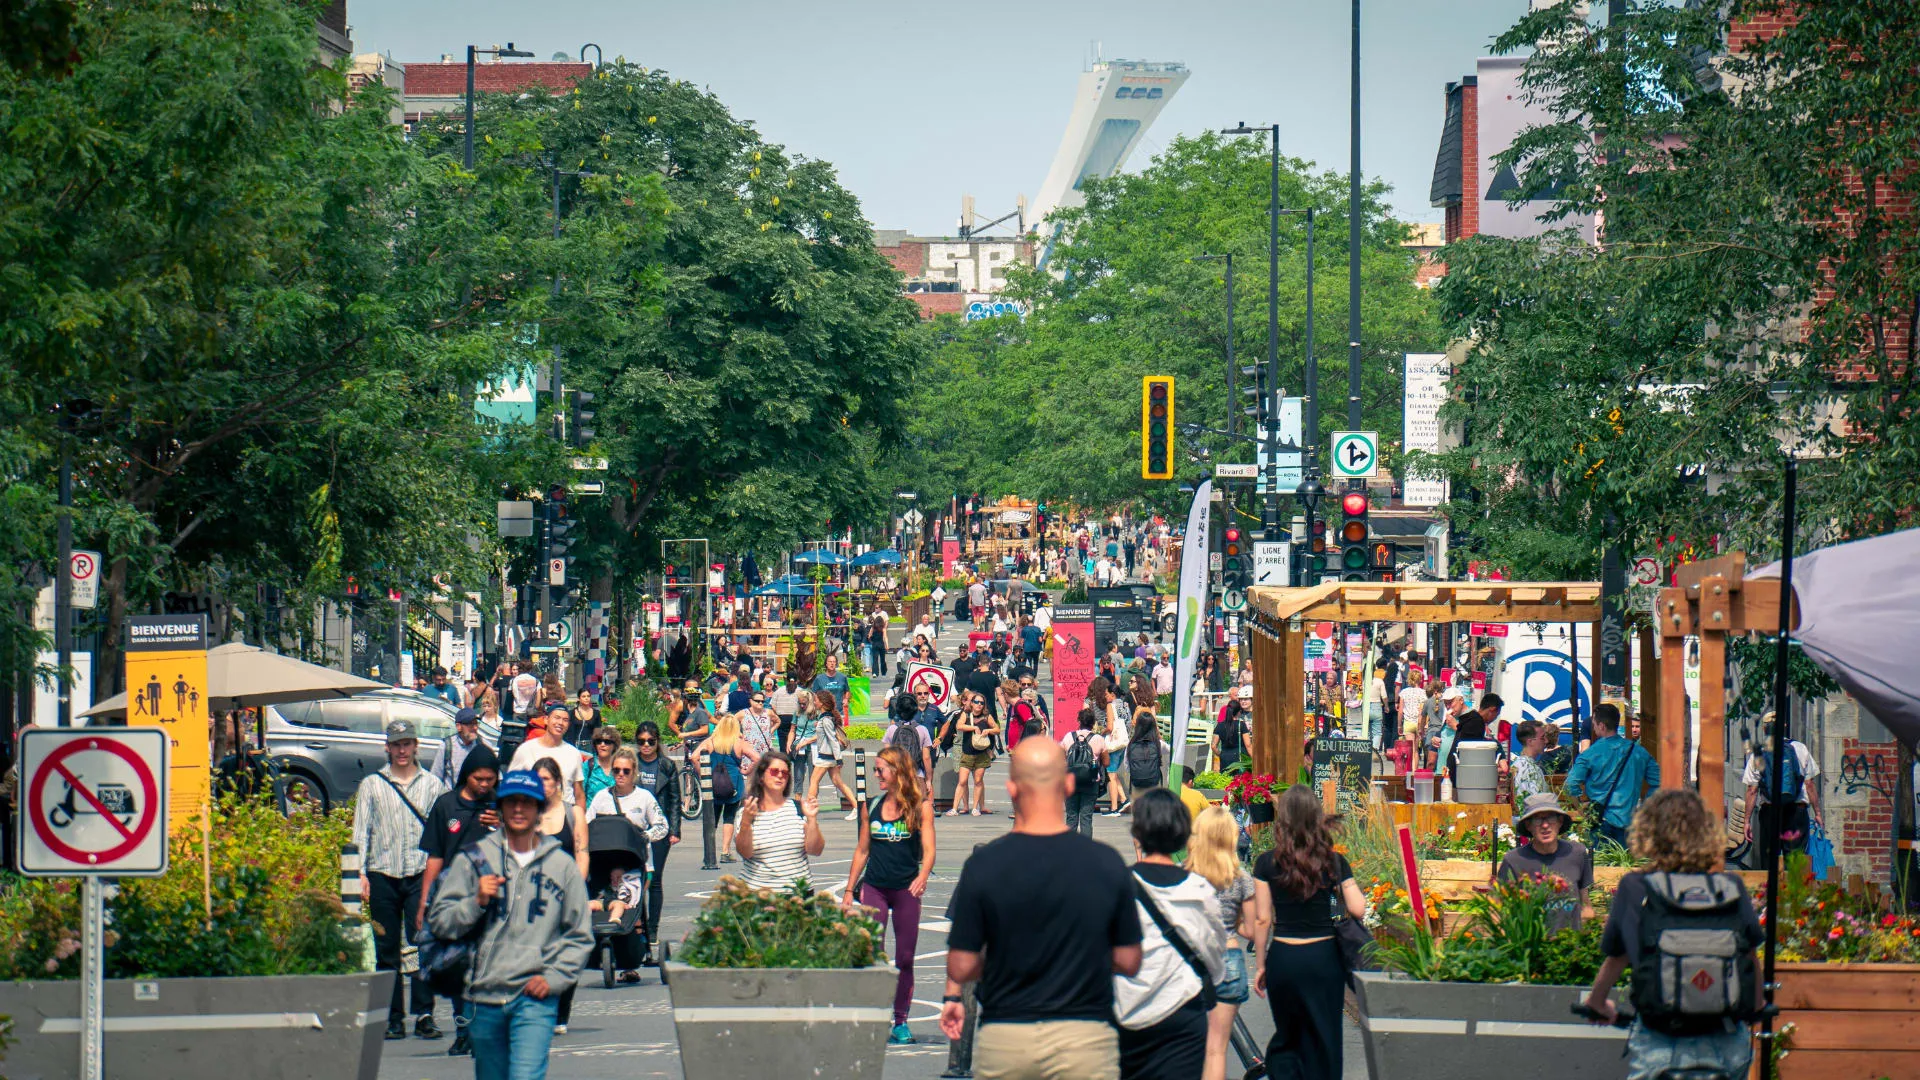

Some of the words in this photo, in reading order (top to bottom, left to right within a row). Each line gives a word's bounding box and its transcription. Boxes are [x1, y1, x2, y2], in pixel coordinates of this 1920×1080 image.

[1262, 547, 1281, 555] LIGNE
[131, 624, 199, 636] BIENVENUE
[1316, 740, 1336, 752] MENU
[1338, 741, 1371, 753] TERRASSE
